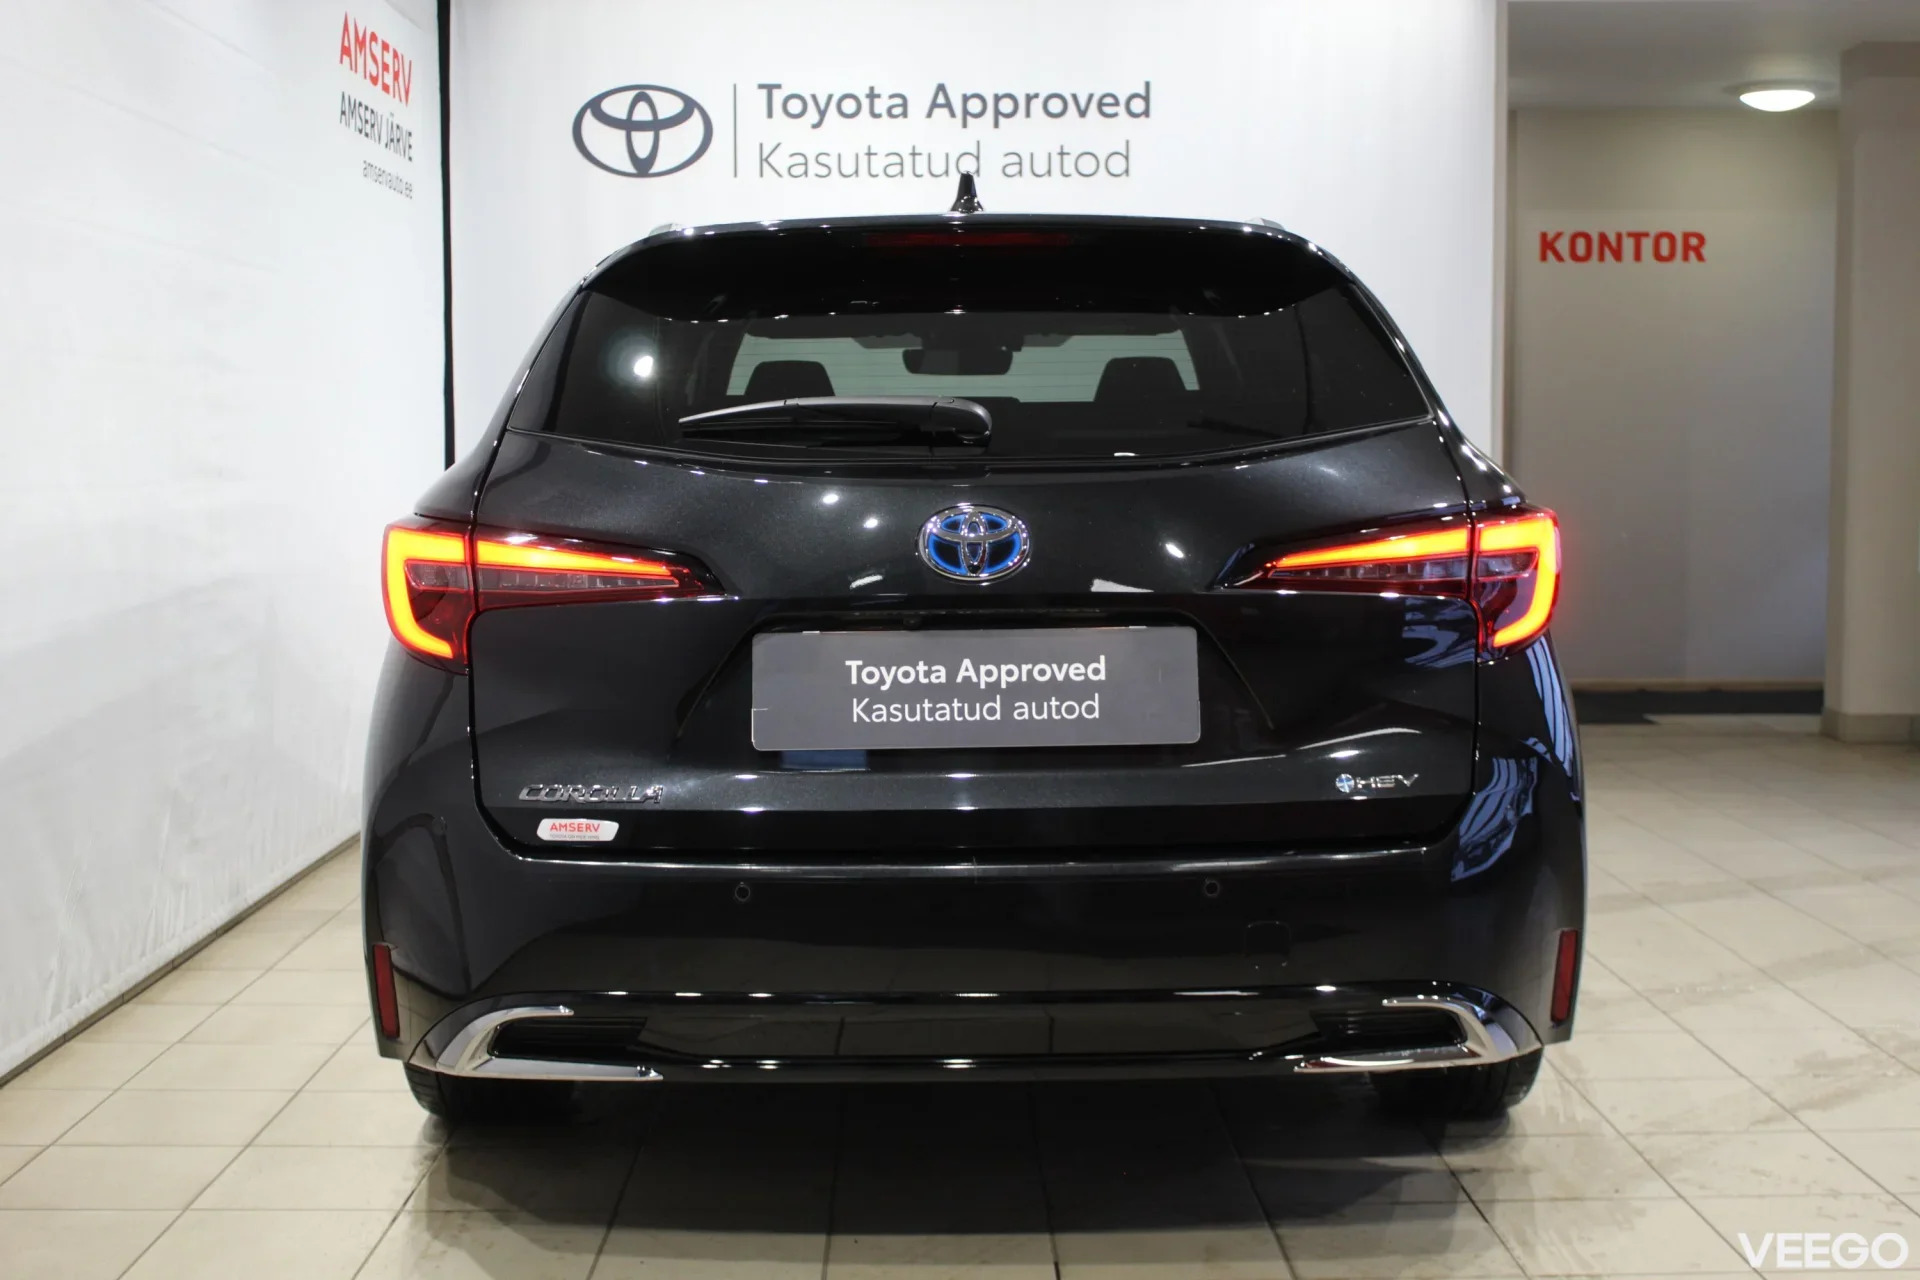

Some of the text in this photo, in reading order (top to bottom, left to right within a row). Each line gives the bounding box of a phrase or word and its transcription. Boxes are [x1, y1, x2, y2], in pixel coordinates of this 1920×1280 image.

[339, 11, 412, 107] AMSERV
[757, 81, 1152, 128] Toyota Approved
[339, 91, 413, 162] AMSERV JÄRVE
[759, 140, 1131, 178] Kasutatud autod
[362, 159, 413, 200] amservauto.ee
[1539, 231, 1707, 263] KONTOR
[845, 656, 1106, 690] Toyota Approved
[852, 694, 1100, 723] Kasutatud autod
[519, 784, 664, 803] COROLLA
[1356, 774, 1419, 788] HEV
[550, 822, 600, 832] AMSERV
